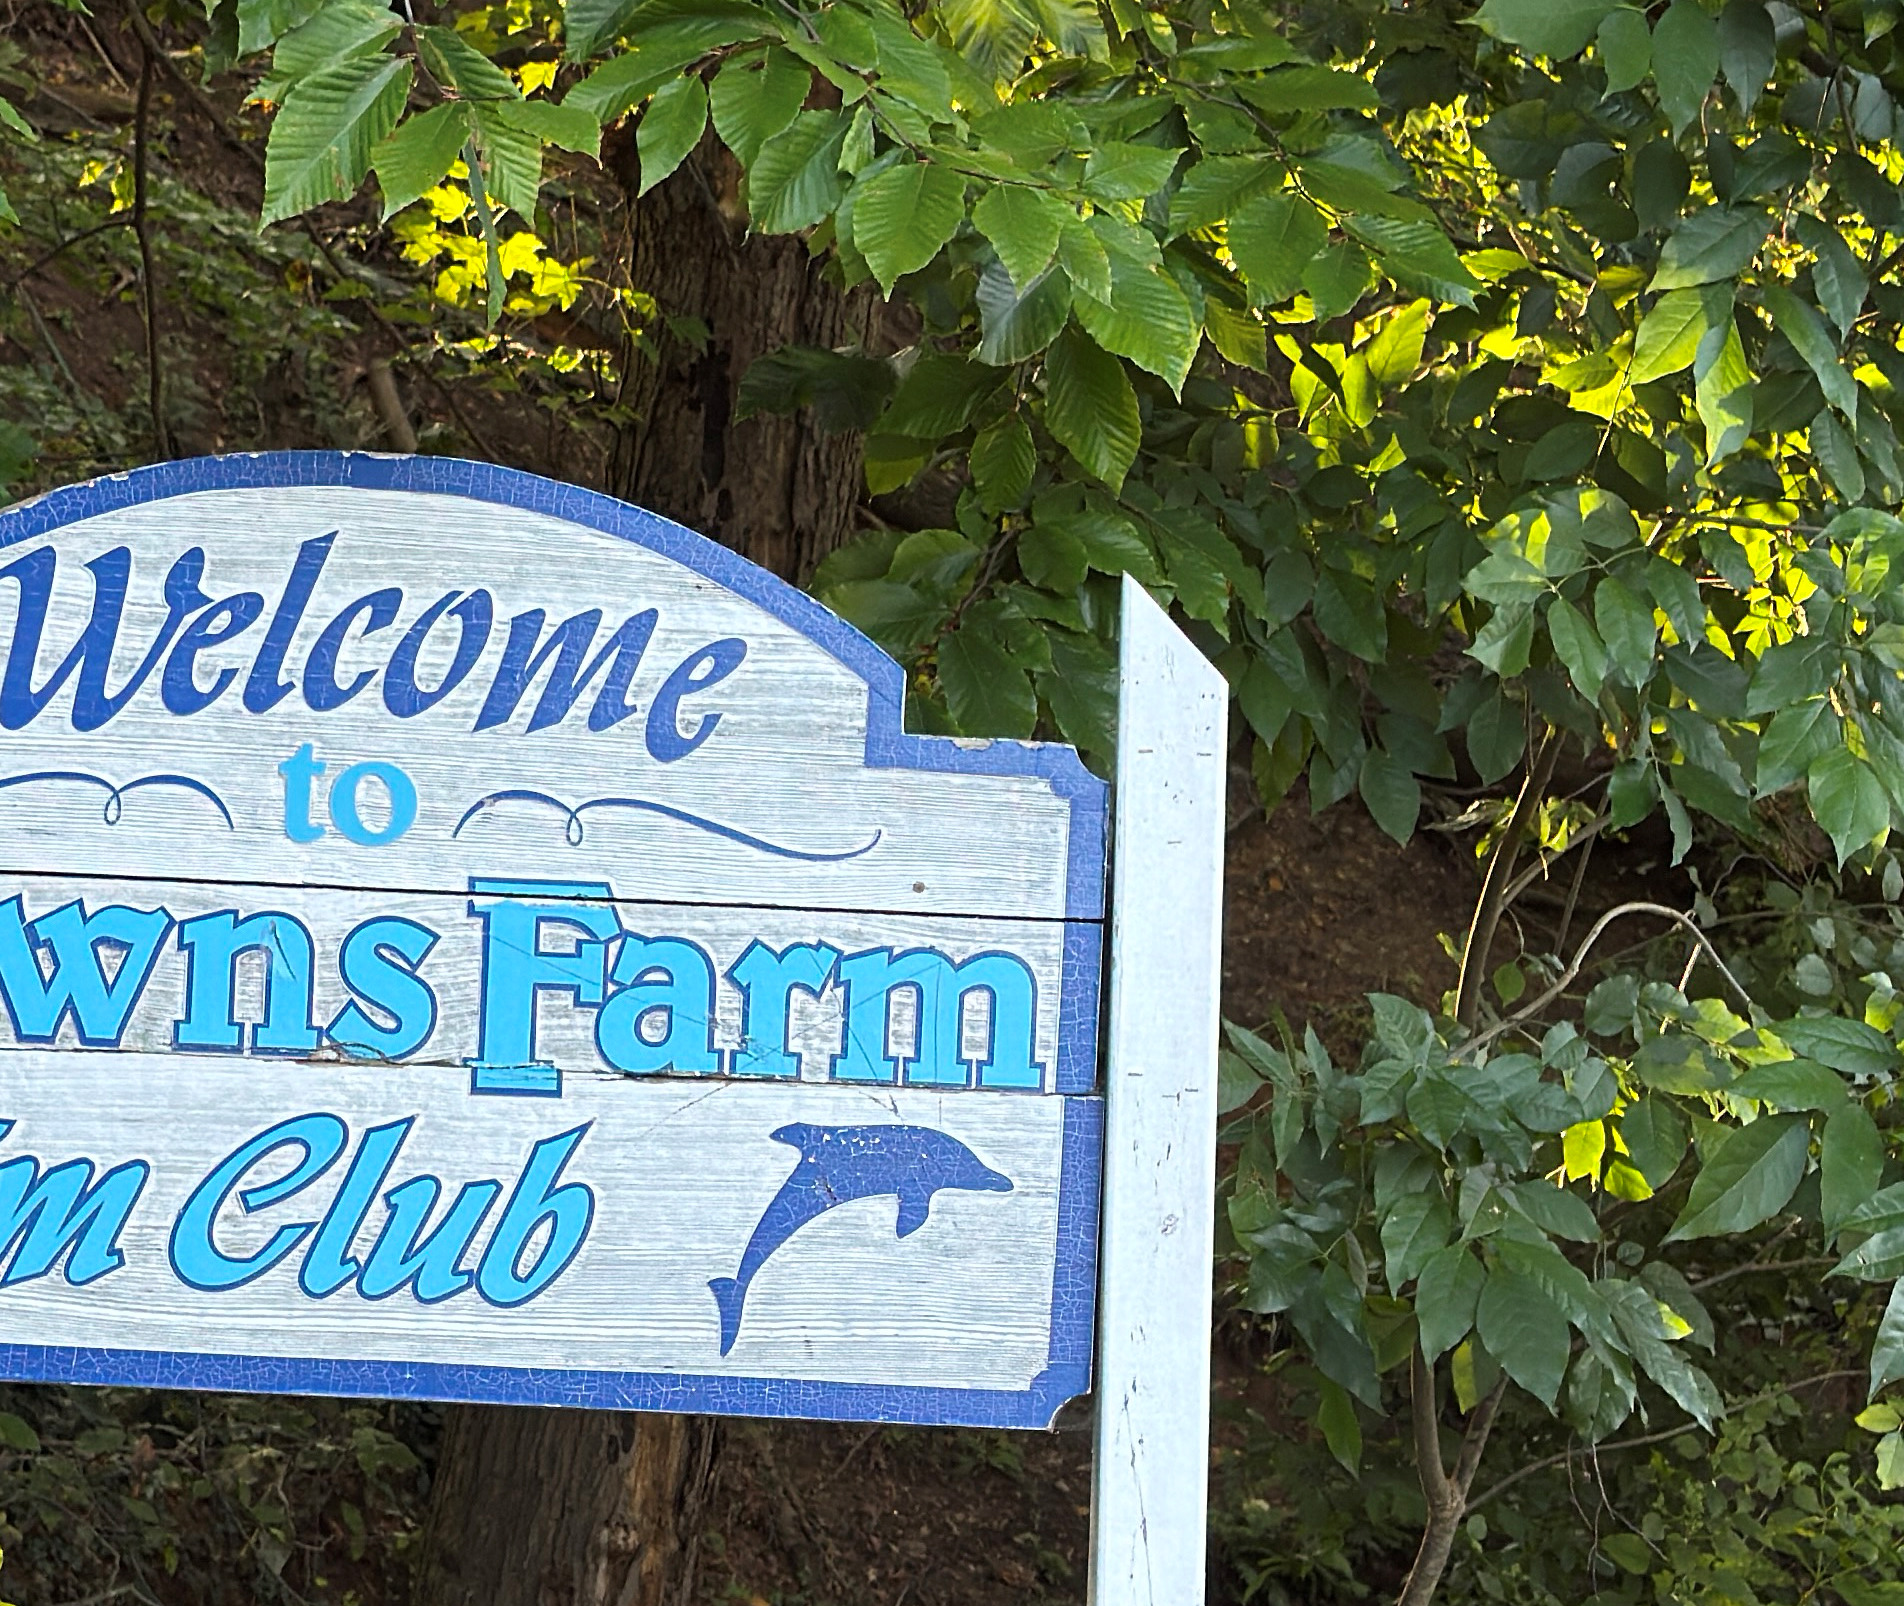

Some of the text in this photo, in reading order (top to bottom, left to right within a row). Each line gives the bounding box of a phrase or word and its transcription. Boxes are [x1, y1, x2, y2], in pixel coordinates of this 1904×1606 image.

[281, 744, 418, 846] to
[468, 878, 1047, 1096] Farm
[169, 1112, 597, 1308] Club
